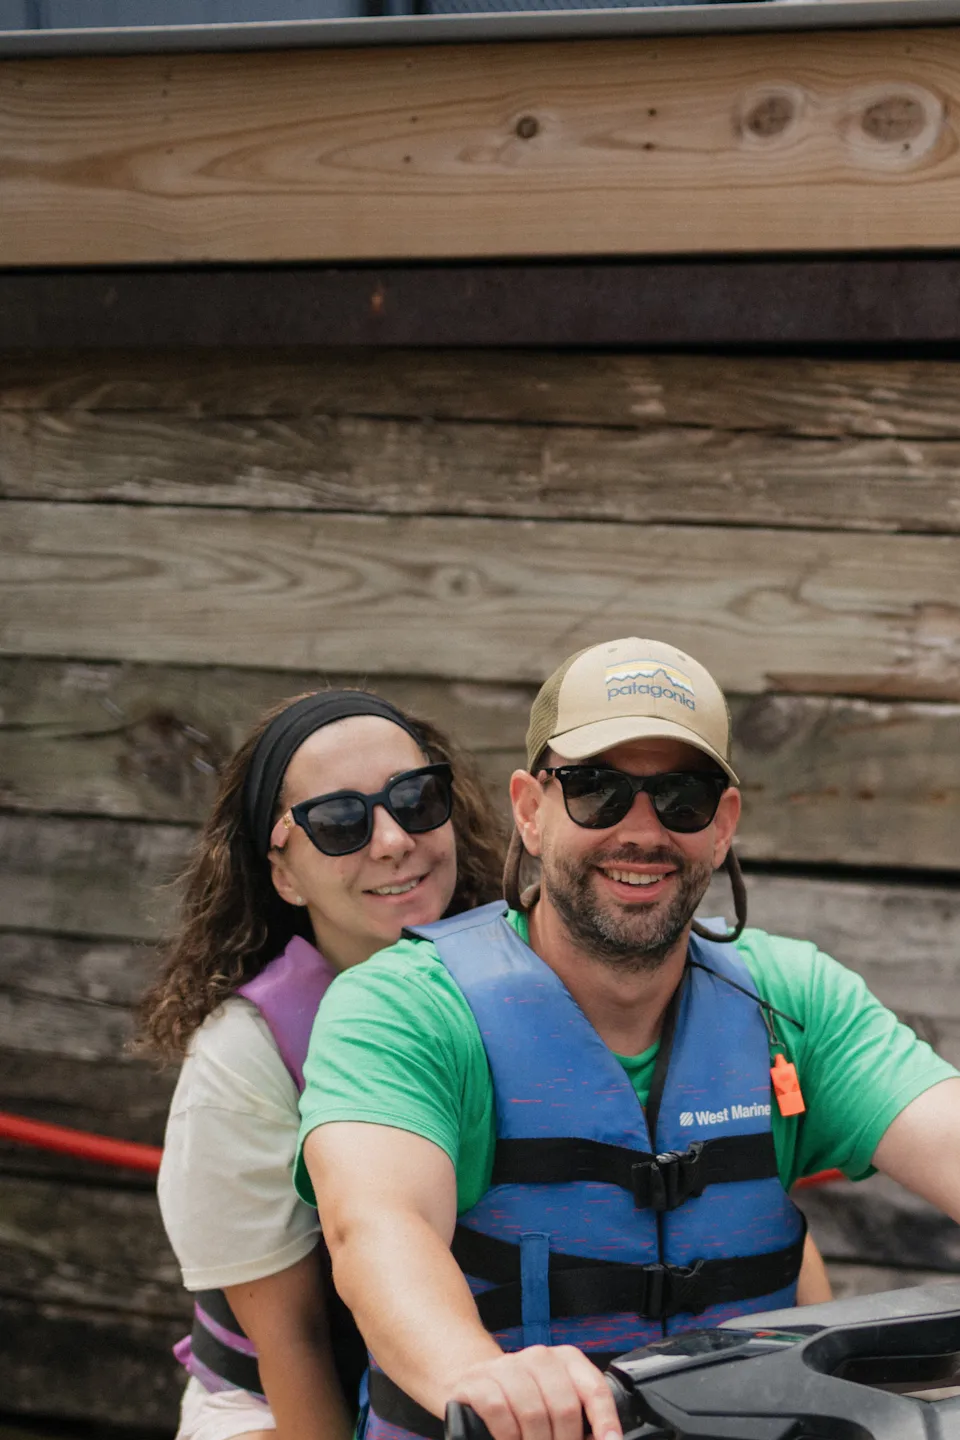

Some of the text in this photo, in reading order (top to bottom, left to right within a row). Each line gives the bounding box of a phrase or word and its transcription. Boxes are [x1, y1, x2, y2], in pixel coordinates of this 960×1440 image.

[606, 681, 696, 711] patagonia
[695, 1102, 771, 1126] West Marine
